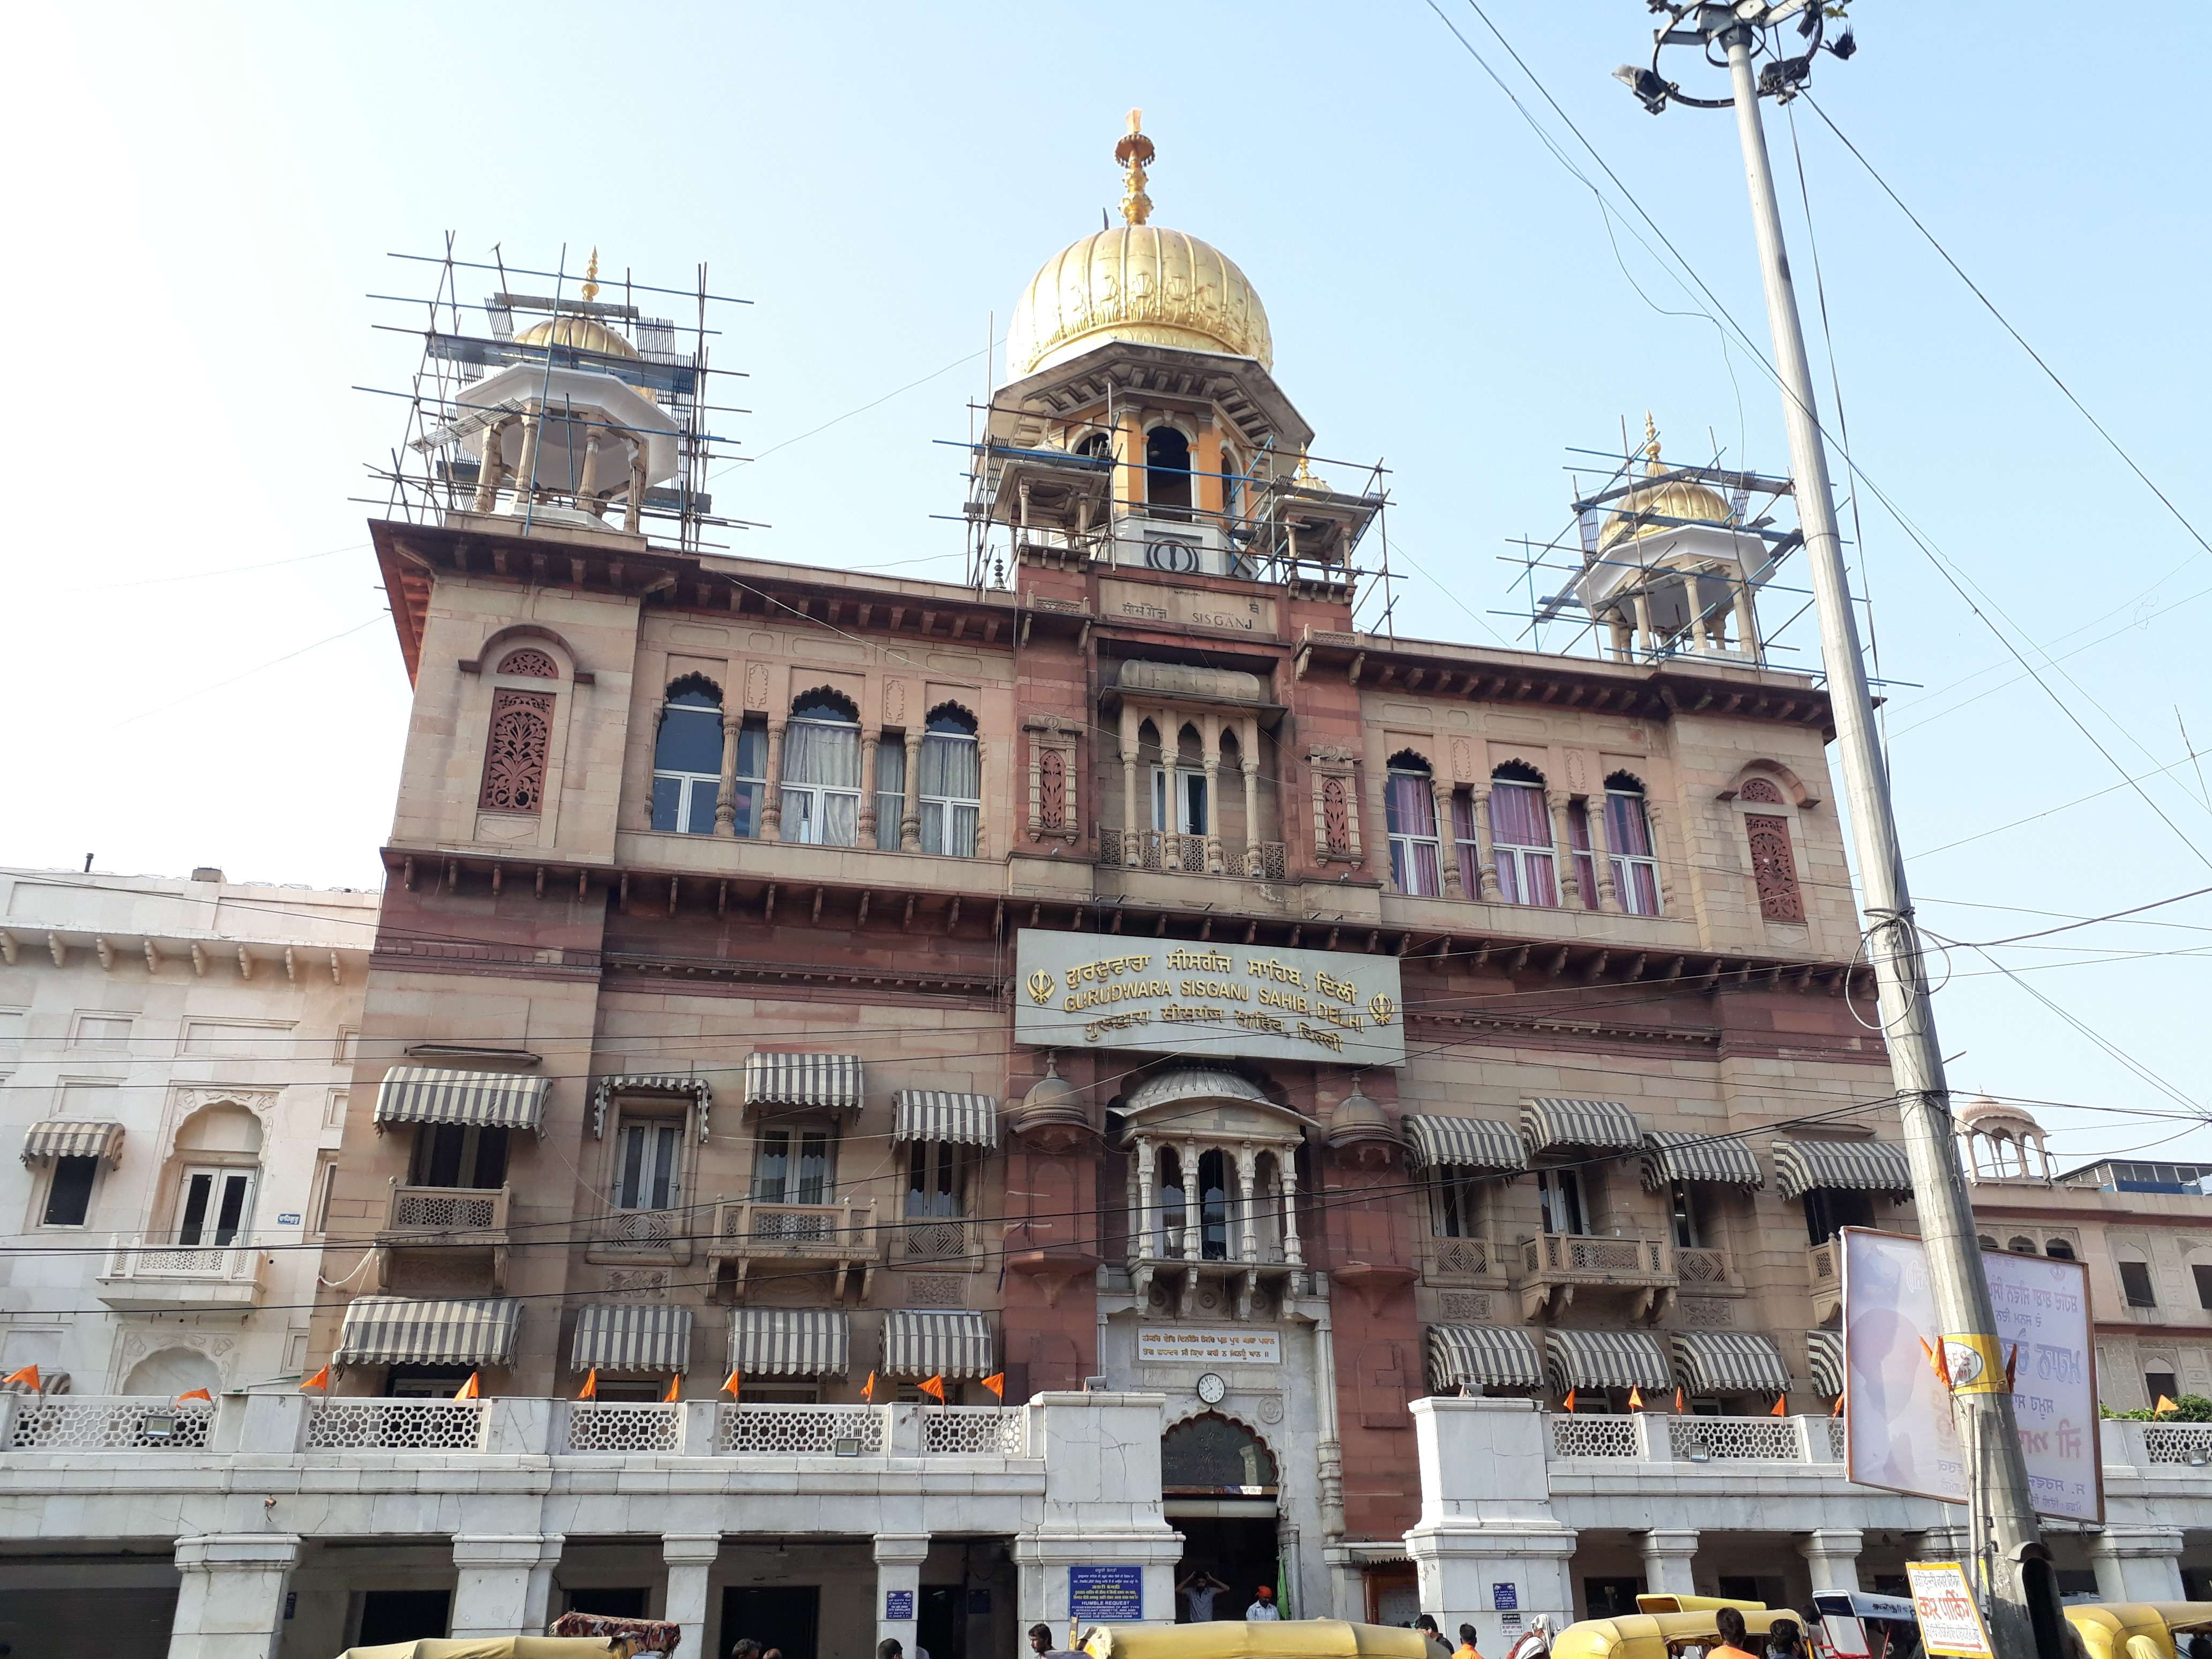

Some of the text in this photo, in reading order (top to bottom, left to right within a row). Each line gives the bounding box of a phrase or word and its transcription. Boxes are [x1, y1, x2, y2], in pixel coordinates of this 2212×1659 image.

[1192, 612, 1252, 630] SISGANJ
[1167, 947, 1232, 973] ਸੀਸਗੰਜ
[1063, 980, 1173, 1013] GURUDWARA
[1180, 979, 1250, 1002] SISGANJ
[1316, 1001, 1364, 1033] DELHI
